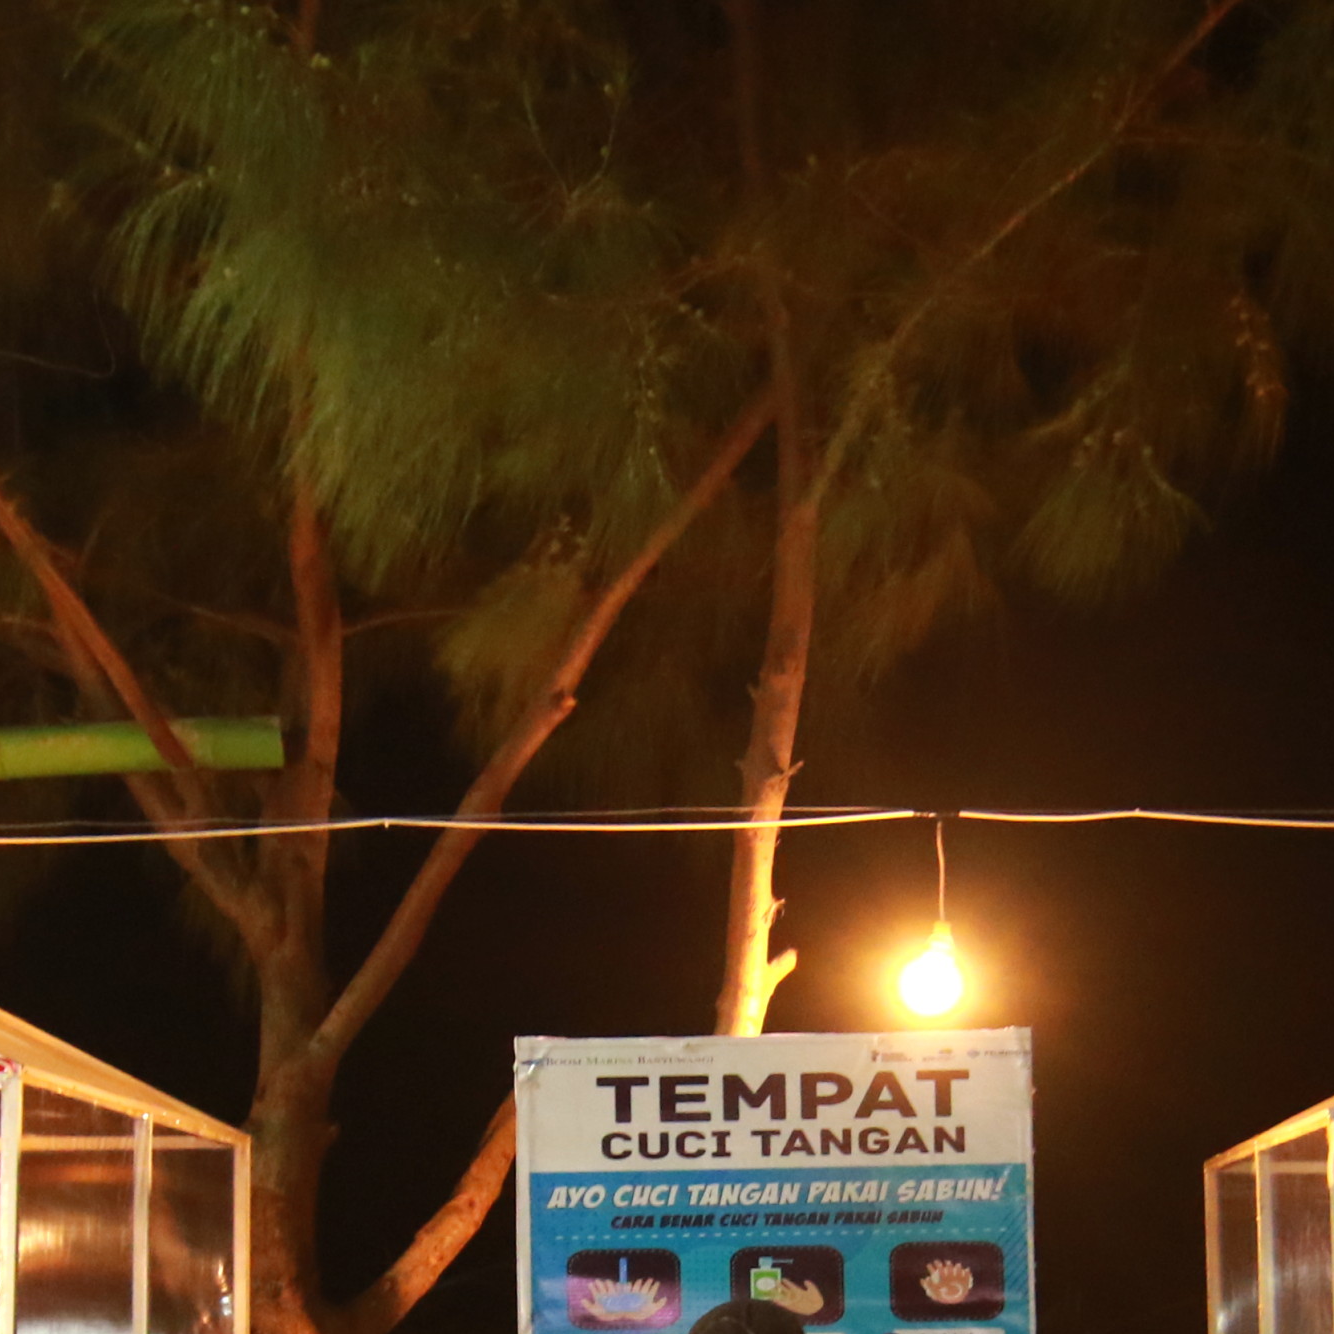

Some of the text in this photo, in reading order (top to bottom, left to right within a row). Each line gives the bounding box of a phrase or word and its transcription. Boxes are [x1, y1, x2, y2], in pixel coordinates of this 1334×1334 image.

[596, 1069, 969, 1124] TEMPAT
[601, 1126, 965, 1160] CUCI TANGAN
[547, 1177, 1007, 1209] AYO CUCI TANGAN PAKAI SABUN!
[610, 1209, 944, 1229] CARA BENAR CUCI TANGAN PAKAI SABUN
